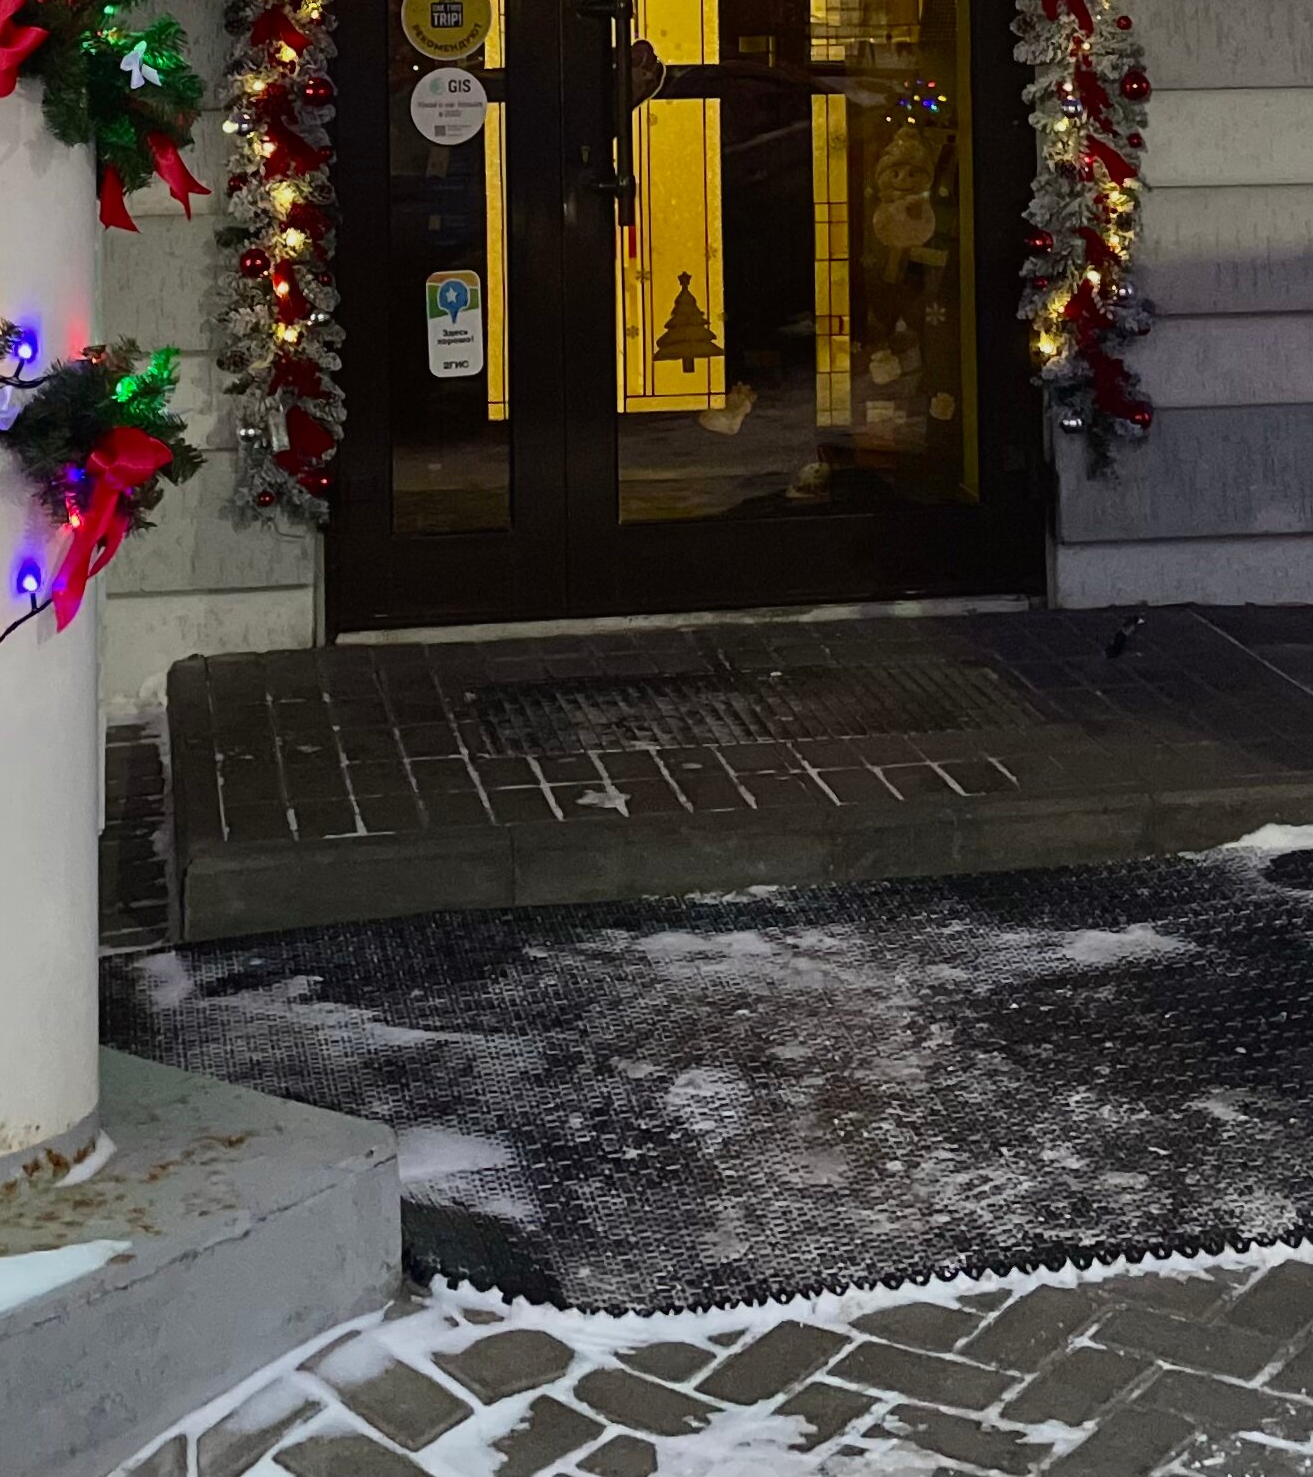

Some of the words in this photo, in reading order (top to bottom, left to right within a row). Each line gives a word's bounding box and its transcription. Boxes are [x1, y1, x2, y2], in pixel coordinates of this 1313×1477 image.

[432, 12, 462, 27] TRIP!
[413, 22, 482, 52] РЕКОМЕНДУЮТ
[448, 78, 472, 94] GIS
[442, 329, 468, 337] Здесь
[443, 360, 469, 369] 2ГИС
